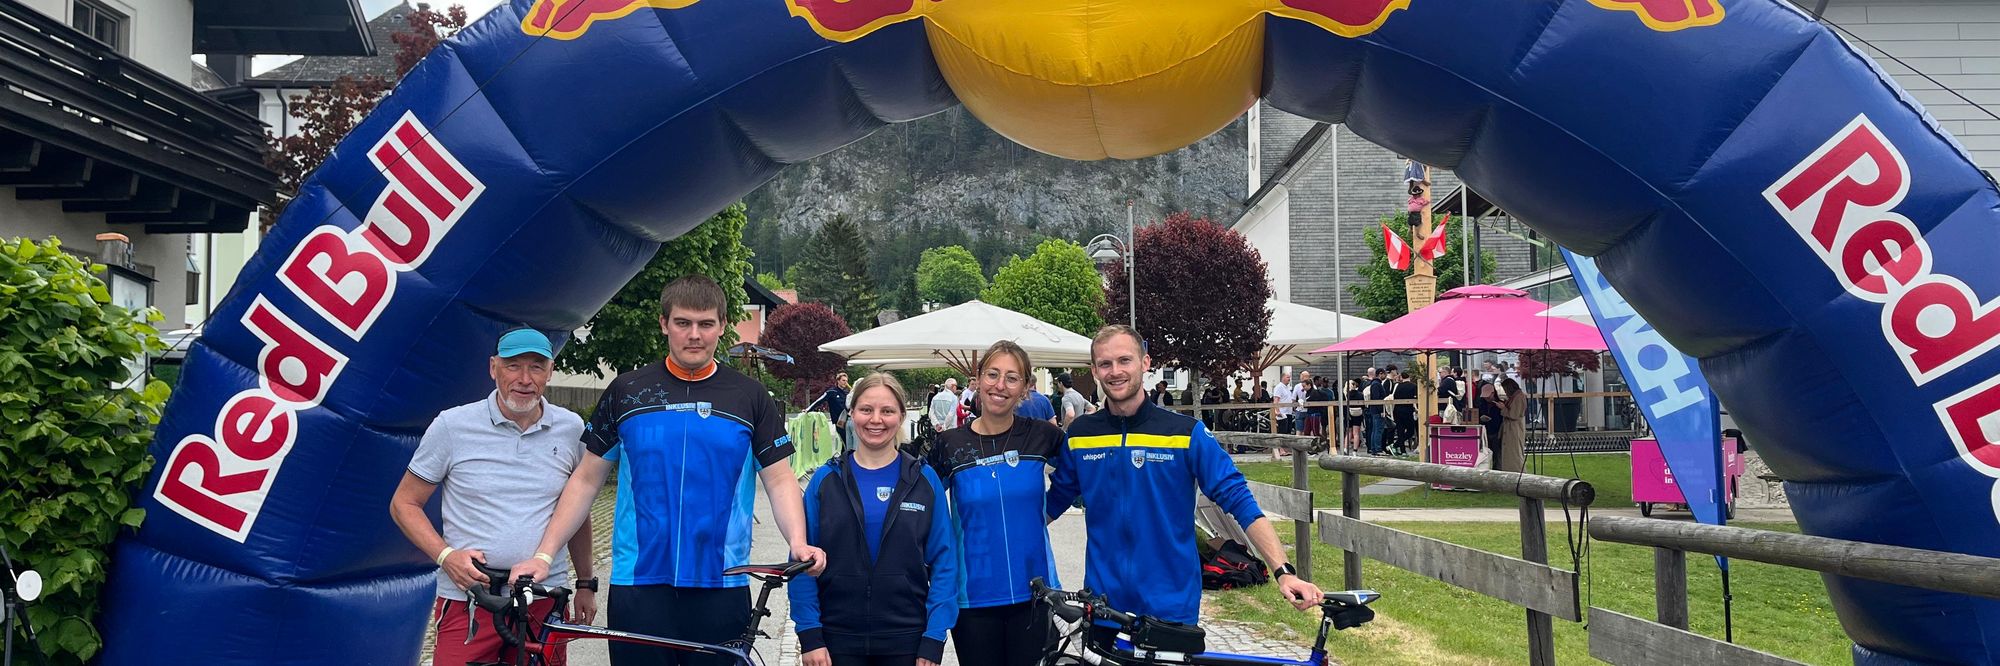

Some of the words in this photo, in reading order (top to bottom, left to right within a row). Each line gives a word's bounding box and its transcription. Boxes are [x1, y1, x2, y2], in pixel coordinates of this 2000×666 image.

[1774, 122, 2000, 377] Red
[159, 301, 339, 535] Red
[281, 117, 477, 334] Bull
[1083, 452, 1106, 461] uhlsport
[1146, 452, 1175, 460] INKLUSIV
[1445, 451, 1472, 462] beazley
